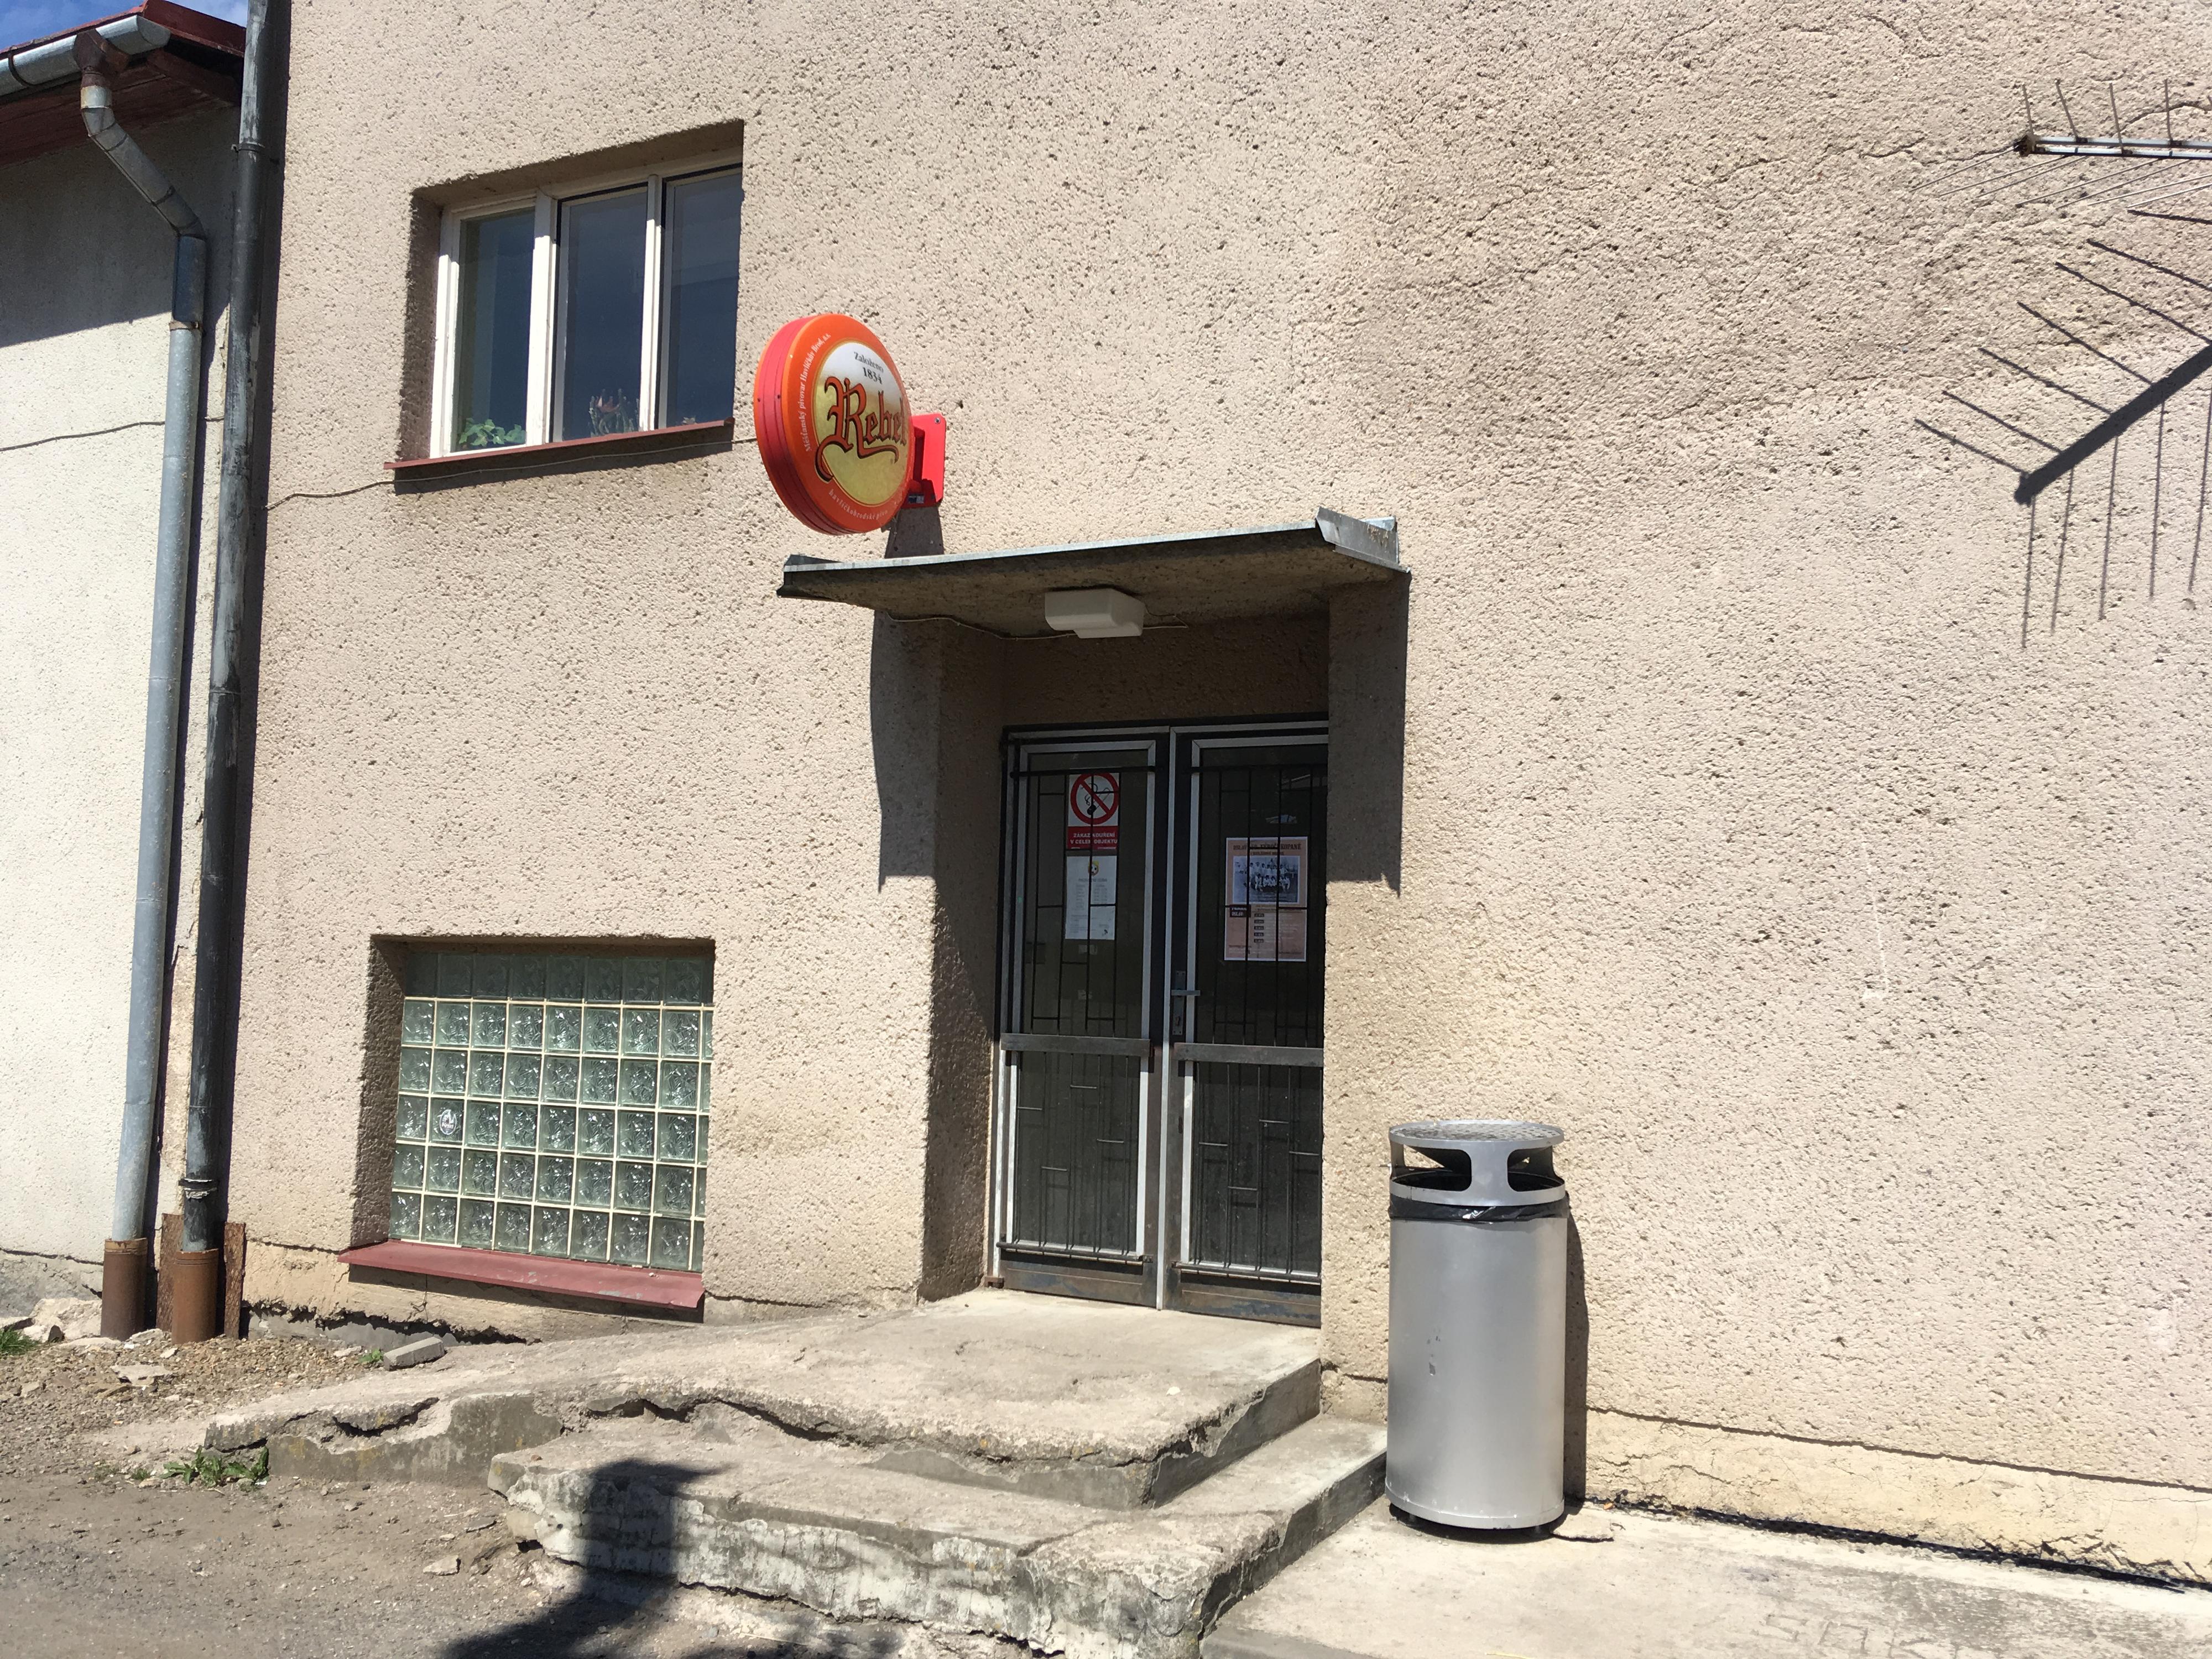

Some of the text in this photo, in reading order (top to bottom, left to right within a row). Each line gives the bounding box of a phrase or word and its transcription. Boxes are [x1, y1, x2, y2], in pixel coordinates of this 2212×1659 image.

[854, 352, 884, 373] Založeno
[863, 367, 882, 384] 1834
[797, 382, 807, 410] pivovar
[815, 376, 907, 482] Rebel
